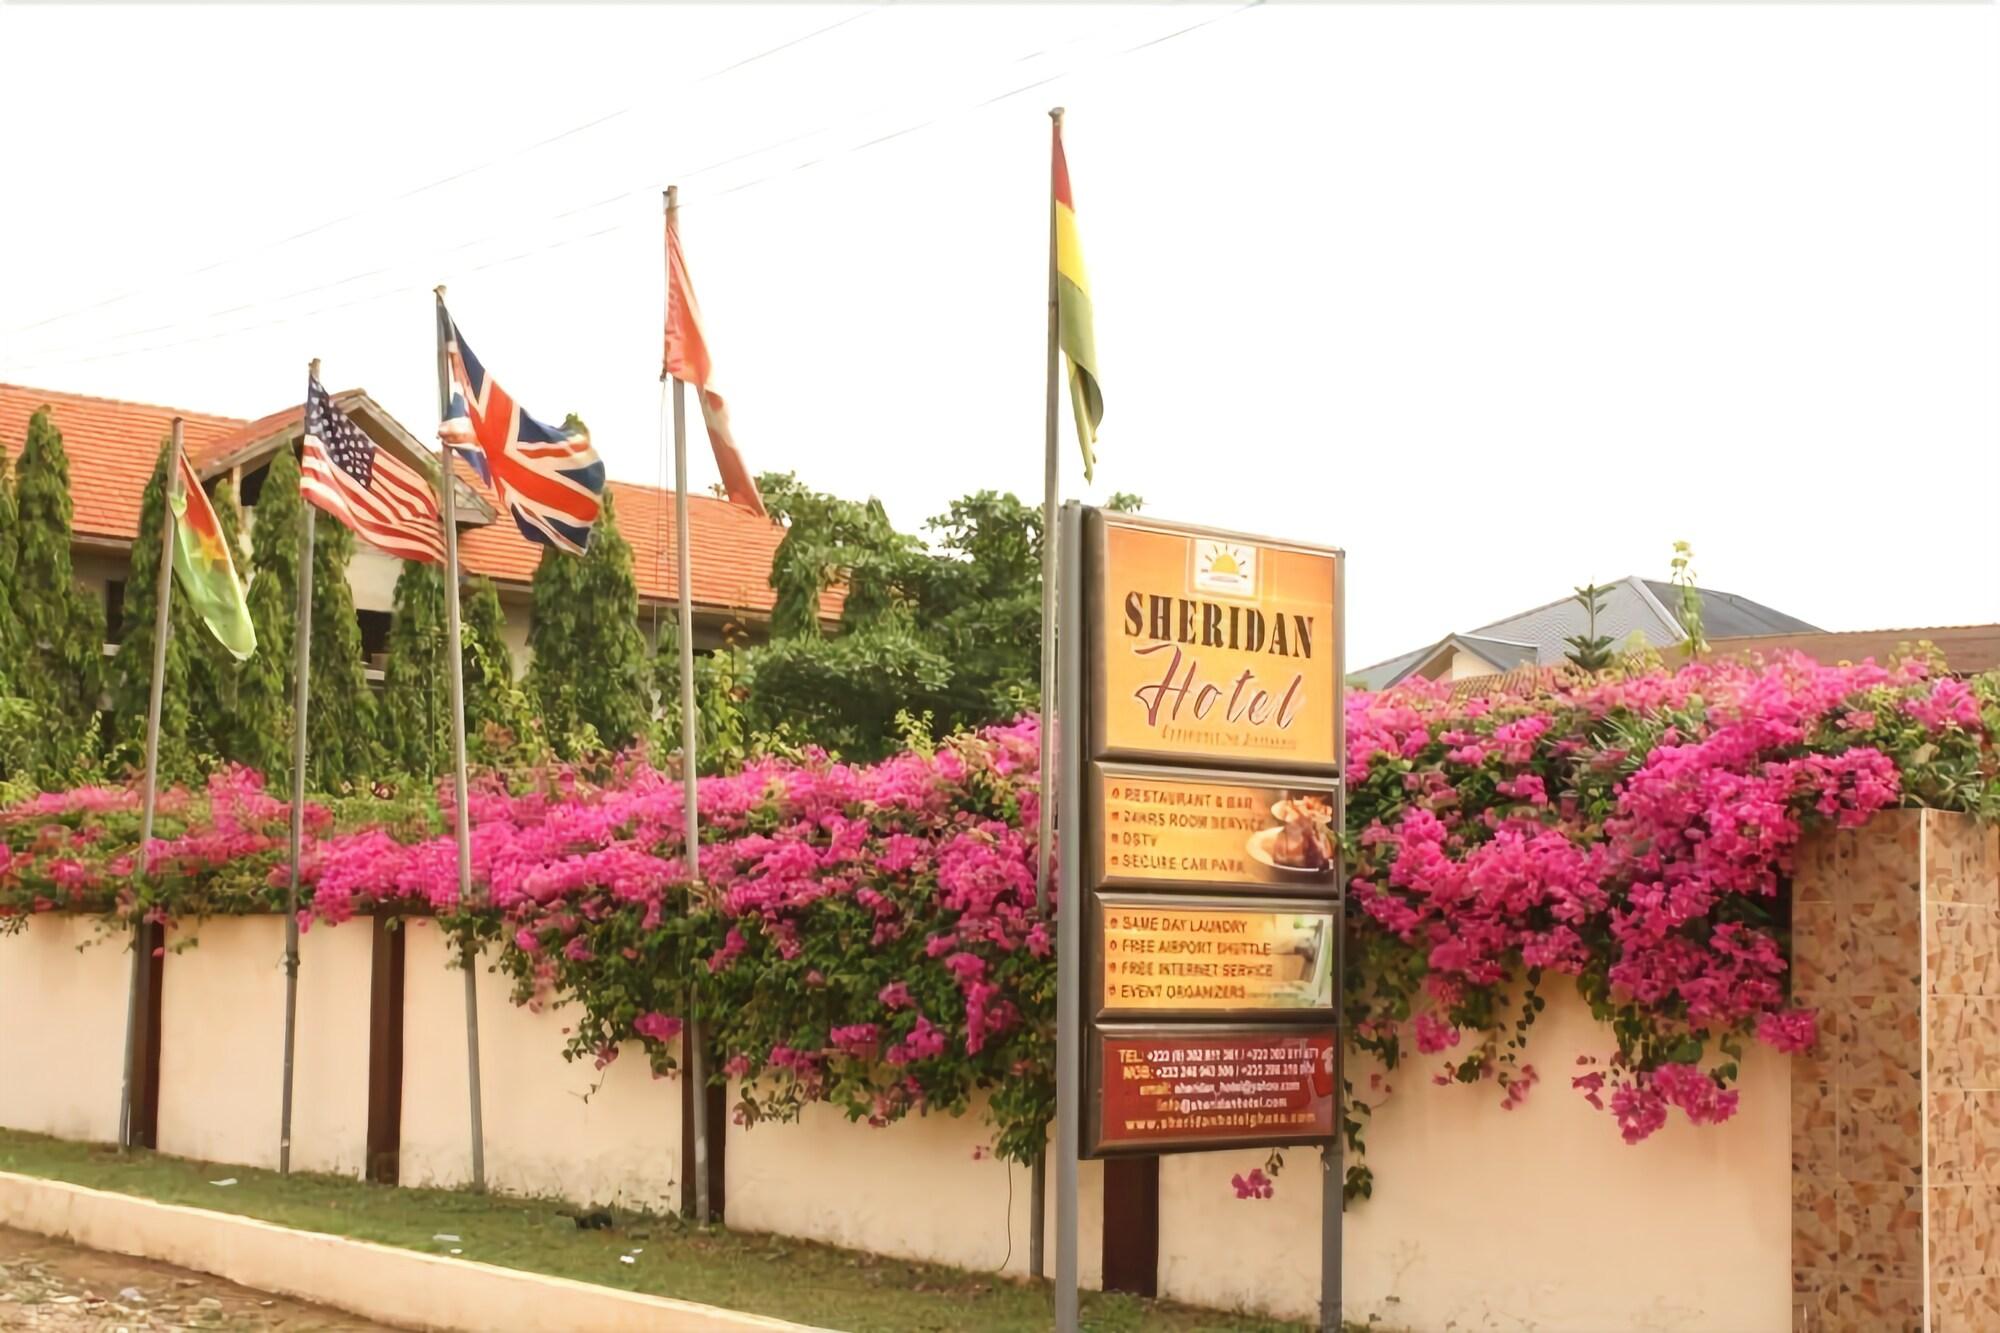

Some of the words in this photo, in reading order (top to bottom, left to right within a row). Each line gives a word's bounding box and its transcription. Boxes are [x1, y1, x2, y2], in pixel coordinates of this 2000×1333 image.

[1125, 590, 1314, 659] SHERIDAN
[1134, 643, 1303, 729] Hotel
[1124, 788, 1211, 806] RESTAURANT
[1226, 796, 1253, 809] BAR
[1169, 812, 1208, 829] ROOM
[1211, 815, 1266, 833] SERVICE
[1122, 854, 1177, 870] SECURE
[1181, 857, 1208, 871] CAR
[1211, 858, 1246, 873] PARK
[1122, 916, 1159, 932] SAME
[1162, 918, 1187, 932] DAY
[1190, 919, 1248, 934] LAUNDRY
[1122, 939, 1155, 953] FREE
[1158, 940, 1213, 955] AIRPORT
[1217, 942, 1272, 956] SHUTTLE
[1121, 961, 1154, 976] FREE
[1159, 962, 1219, 977] INTERNET
[1222, 964, 1273, 977] SERVICE
[1121, 984, 1162, 999] EVENT
[1166, 985, 1246, 999] ORGANIZERS
